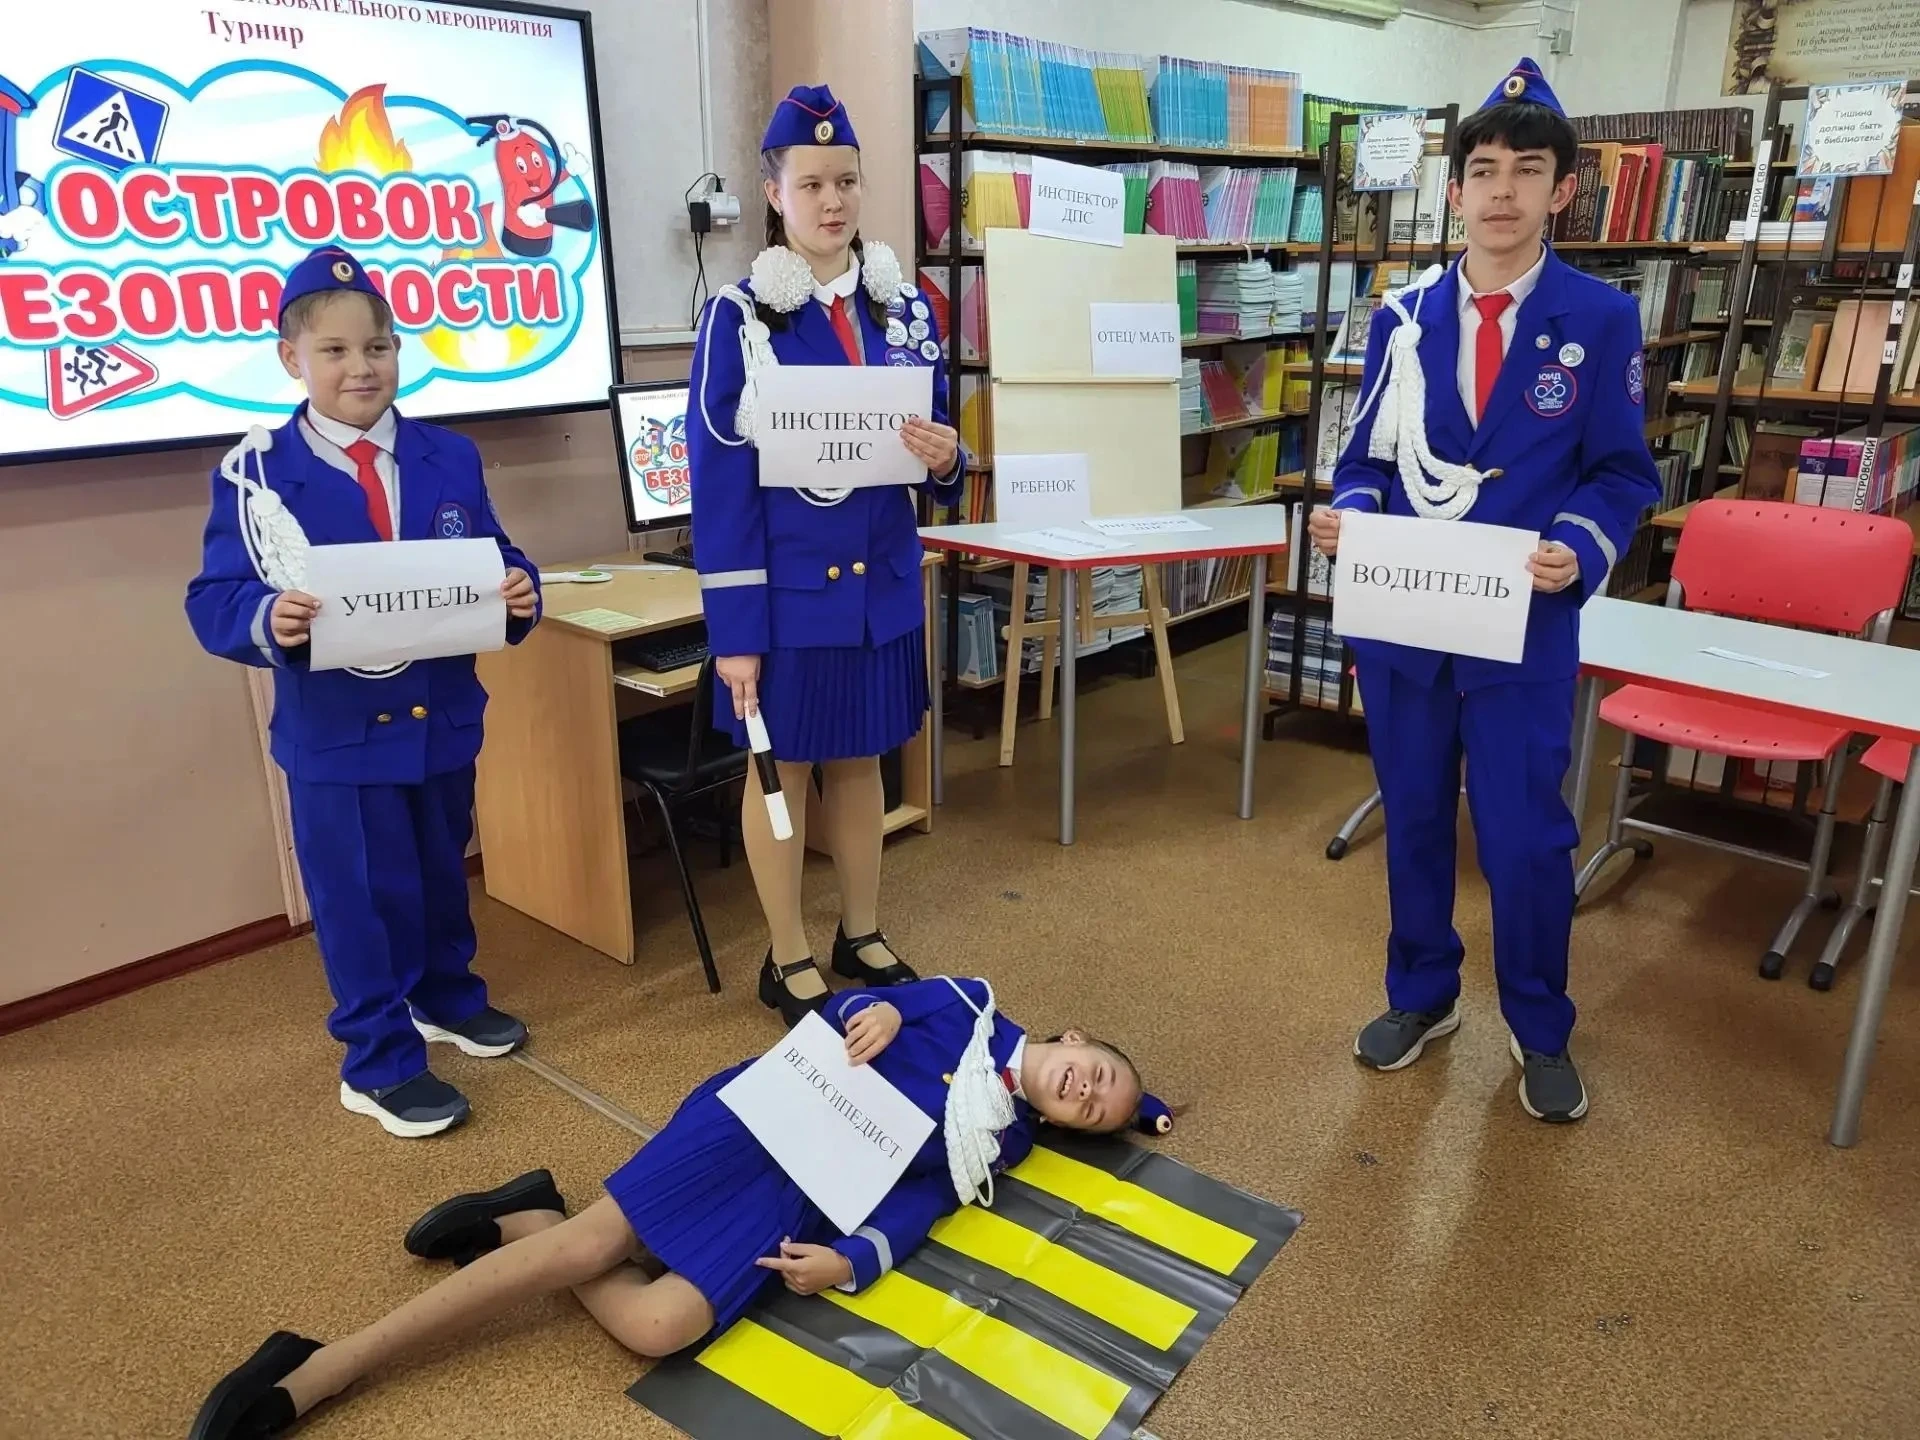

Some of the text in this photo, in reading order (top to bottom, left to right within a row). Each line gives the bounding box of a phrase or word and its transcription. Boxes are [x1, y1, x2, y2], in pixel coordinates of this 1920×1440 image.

[201, 10, 305, 49] Турнир
[234, 0, 554, 38] ОВАТЕЛЬНОГО МЕРОПРИЯТИЯ
[1819, 121, 1883, 133] должна быть
[1834, 110, 1873, 118] Тишина
[1824, 133, 1884, 145] библиотеке!
[1037, 184, 1119, 210] ИНСПЕКТОР
[1750, 163, 1767, 218] ГЕРОИ СВО
[57, 171, 481, 243] ОСТРОВОК
[1061, 208, 1094, 225] ДПС
[1, 268, 560, 338] ЕЗОПАОСТИ
[1097, 331, 1175, 344] ОТЕЦ/ МАТЬ
[1538, 372, 1562, 381] ЮИД
[817, 442, 873, 464] ДПС
[1011, 479, 1076, 494] РЕБЕНОК
[1352, 563, 1510, 599] ВОДИТЕЛЬ
[340, 585, 480, 616] УЧИТЕЛЬ
[783, 1047, 903, 1160] ВЕЛОСИПЕДИСТ
